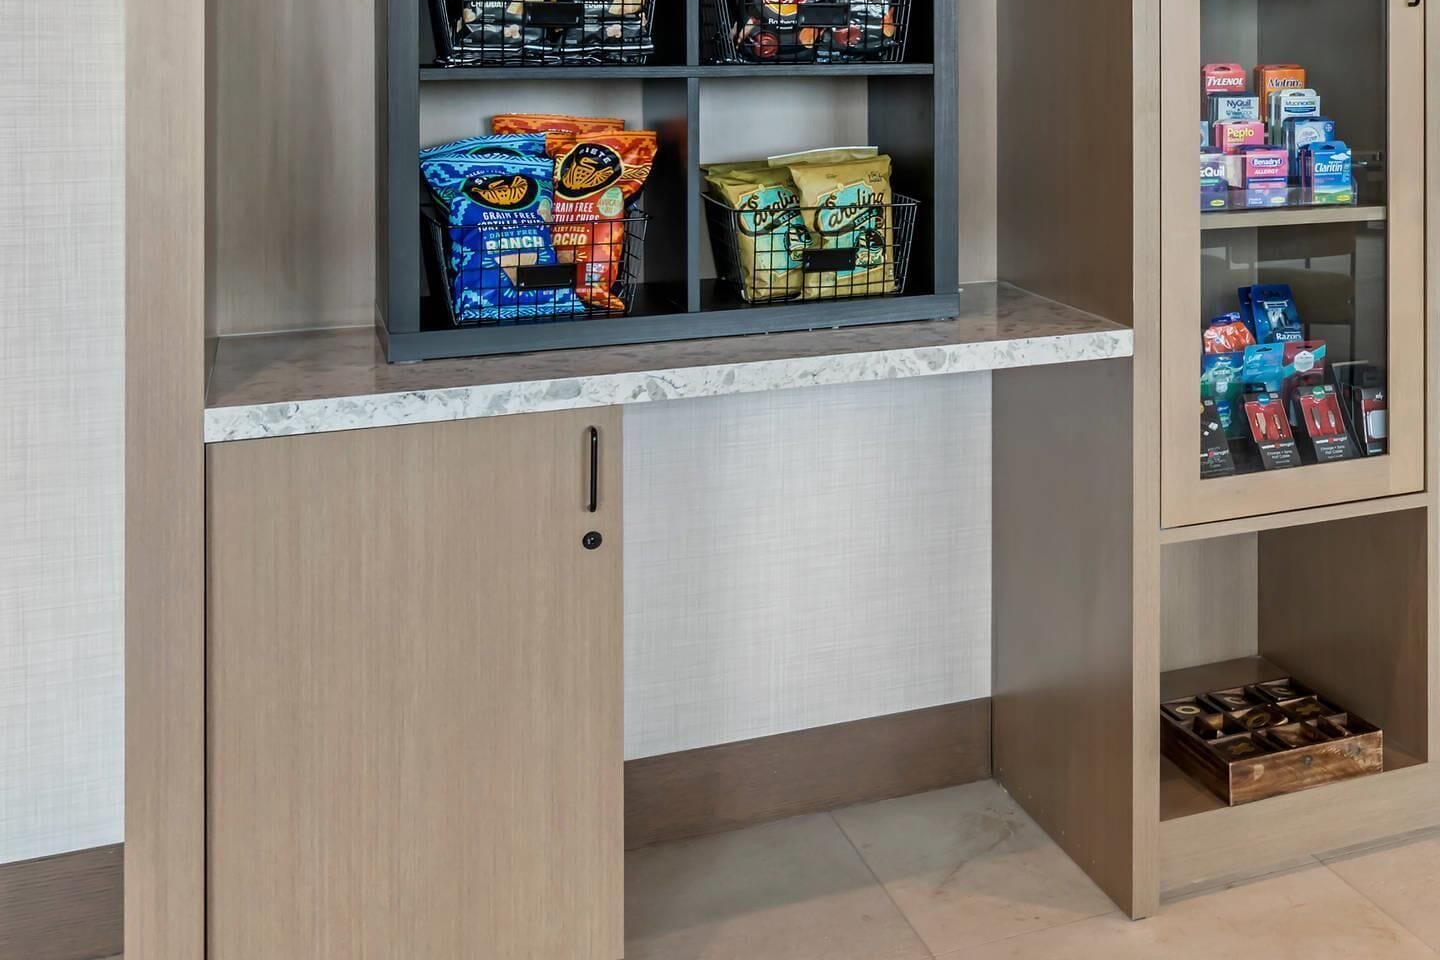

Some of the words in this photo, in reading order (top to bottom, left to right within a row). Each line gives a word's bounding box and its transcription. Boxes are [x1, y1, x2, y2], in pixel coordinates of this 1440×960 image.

[1207, 76, 1243, 88] TYLENOL
[1268, 78, 1299, 88] Motrin
[1226, 99, 1251, 108] NyQuil
[1227, 127, 1255, 138] Pepto
[1253, 158, 1281, 167] Benadryl
[1314, 162, 1343, 173] Claritin
[553, 201, 573, 212] RAIN
[575, 201, 593, 213] FREE
[482, 212, 512, 221] GRAIN
[514, 212, 537, 220] FREE
[485, 236, 545, 253] RANCH
[552, 233, 588, 246] ACHO
[1275, 332, 1302, 340] Razors
